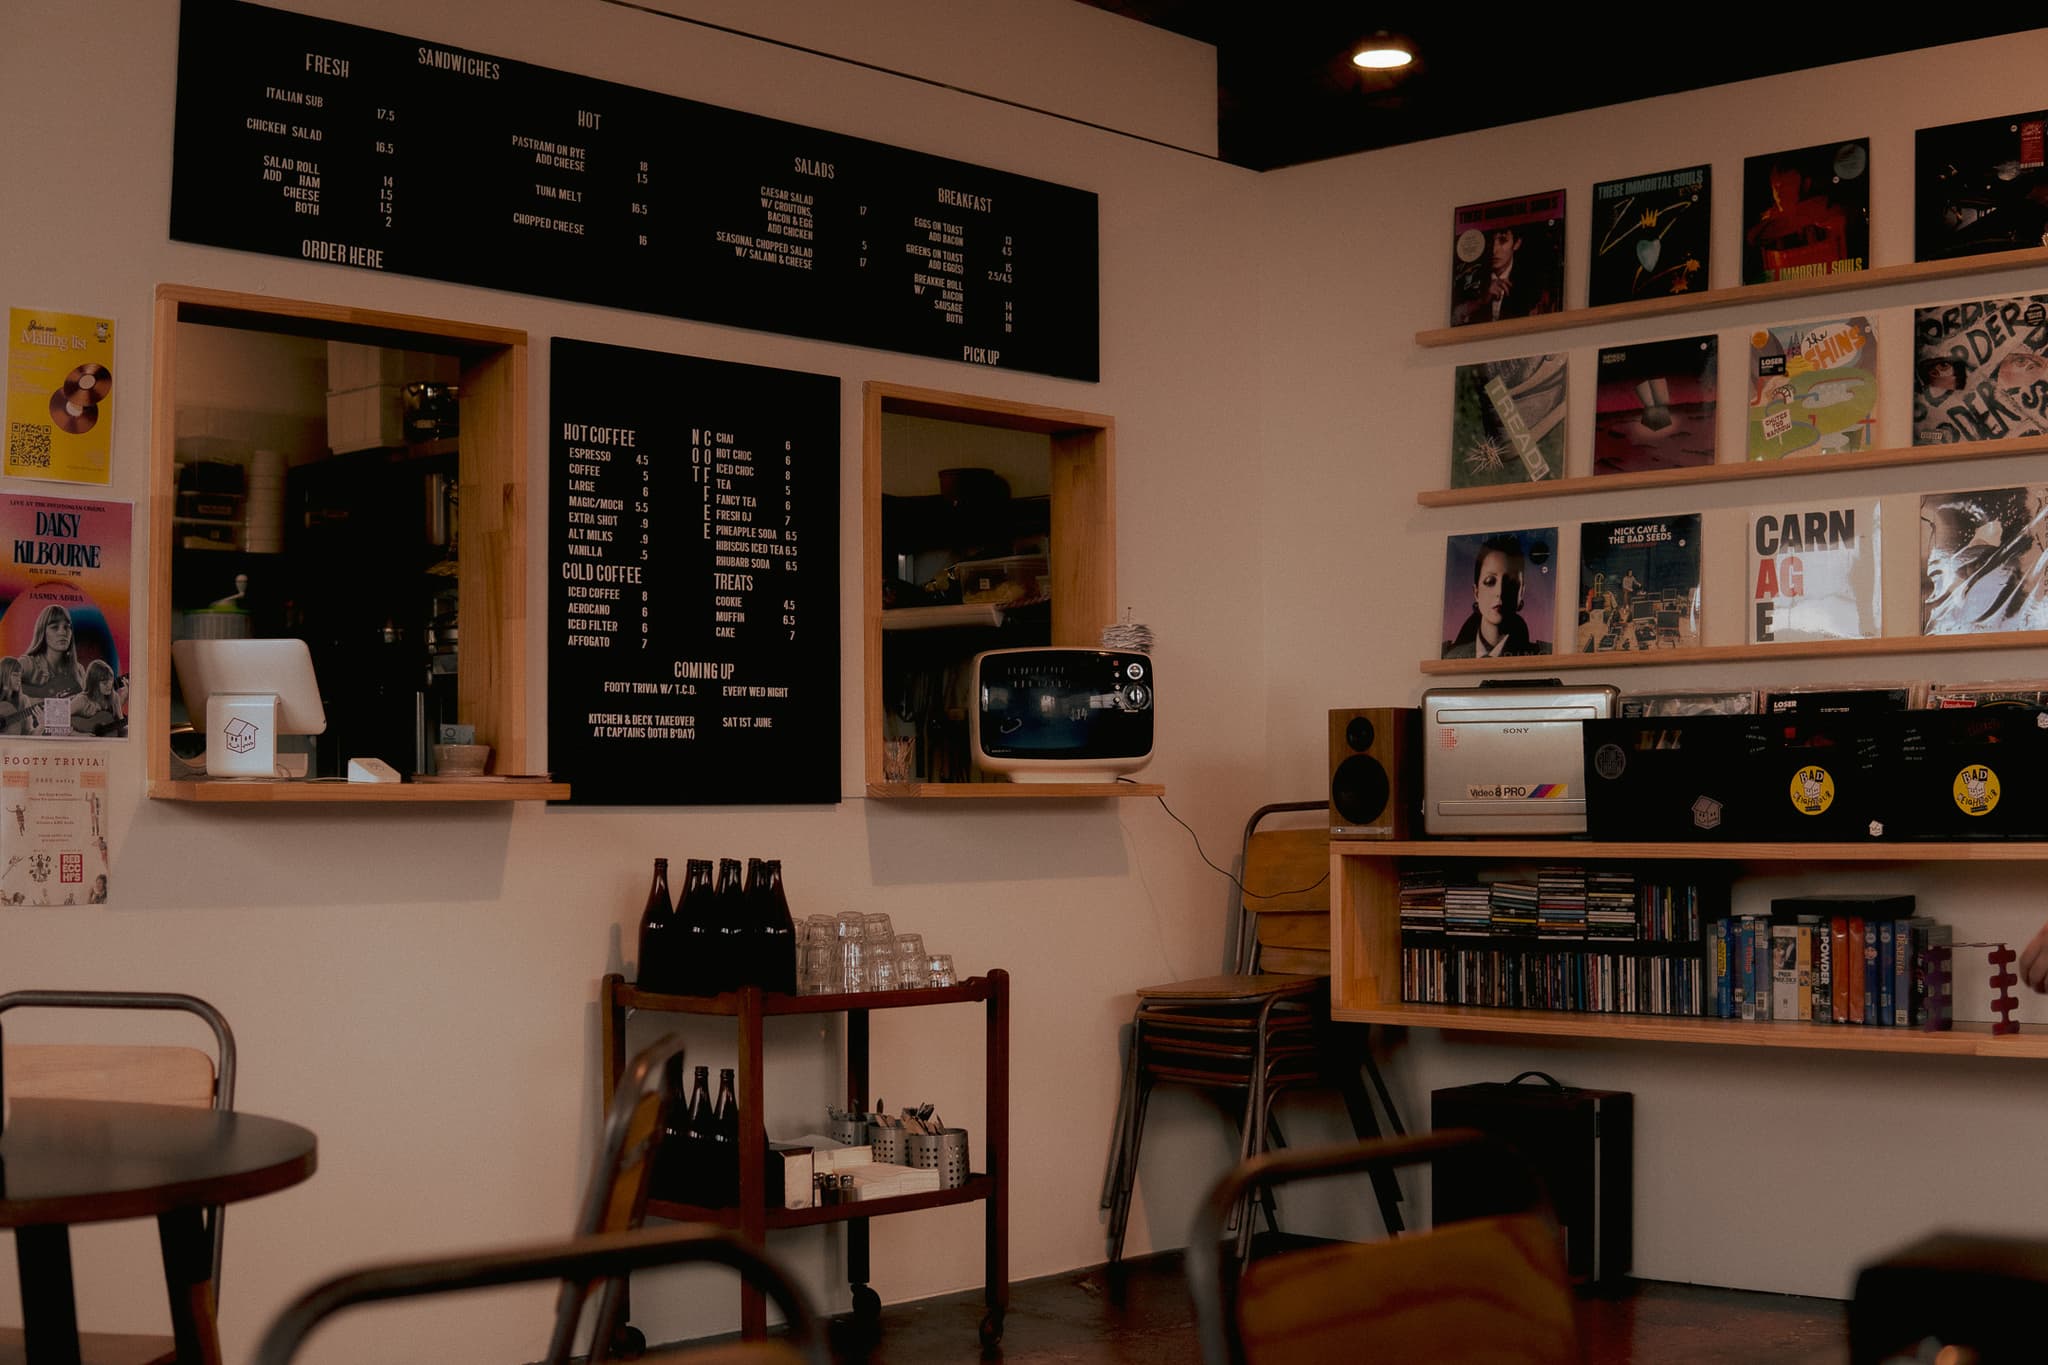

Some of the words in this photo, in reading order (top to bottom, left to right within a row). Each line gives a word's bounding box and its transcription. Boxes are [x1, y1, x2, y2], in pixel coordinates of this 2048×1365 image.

[305, 53, 350, 78] FRESH
[418, 48, 500, 80] SANDWICHES
[266, 86, 303, 104] ITALIAN
[305, 95, 324, 108] SUB
[377, 108, 395, 121] 17.5
[578, 110, 601, 131] HOT
[247, 118, 286, 135] CHICKEN
[292, 125, 322, 141] SALAD
[376, 142, 394, 154] 16.5
[512, 135, 555, 154] PASTRAMI
[557, 143, 568, 157] ON
[570, 147, 586, 160] RYE
[263, 155, 294, 171] SALAD
[296, 160, 321, 175] ROLL
[536, 153, 551, 166] ADD
[554, 156, 585, 172] CHEESE
[794, 157, 835, 180] SALADS
[263, 168, 282, 182] ADD
[299, 175, 321, 189] HAM
[383, 176, 393, 188] 14
[1598, 183, 1624, 200] THESE
[1625, 176, 1672, 195] IMMORTAL
[1673, 170, 1703, 187] SOULS
[283, 186, 320, 202] CHEESE
[536, 184, 556, 198] TUNA
[558, 189, 582, 203] MELT
[761, 186, 788, 201] CAESAR
[790, 192, 814, 205] SALAD
[938, 187, 992, 213] BREAKFAST
[295, 202, 320, 216] BOTH
[513, 212, 551, 230] CHOPPED
[553, 219, 585, 235] CHEESE
[768, 211, 790, 224] BACON
[800, 218, 813, 228] EGG
[914, 217, 931, 228] EGGS
[943, 223, 963, 236] TOAST
[768, 223, 782, 234] ADD
[783, 226, 813, 240] CHICKEN
[716, 231, 754, 248] SEASONAL
[756, 238, 788, 254] CHOPPED
[790, 244, 813, 258] SALAD
[929, 232, 941, 242] ADD
[943, 234, 964, 247] BACON
[302, 239, 346, 263] ORDER
[349, 245, 384, 269] HERE
[749, 249, 777, 263] SALAMI
[786, 256, 813, 270] CHEESE
[906, 244, 931, 257] GREENS
[943, 251, 964, 263] TOAST
[1779, 261, 1831, 281] IMMORTAL
[947, 280, 964, 291] ROLL
[943, 290, 964, 302] BACON
[934, 300, 963, 313] SAUSAGE
[946, 313, 963, 324] BOTH
[21, 330, 68, 351] Mailing
[72, 336, 87, 349] list
[1806, 331, 1827, 348] the
[1804, 325, 1866, 370] SHINS
[964, 345, 986, 364] PICK
[987, 350, 1000, 366] UP
[1761, 358, 1784, 366] LOSER
[1765, 412, 1788, 427] CHUTES
[563, 422, 589, 443] HOT
[590, 425, 636, 448] COFFEE
[716, 432, 734, 445] CHAI
[569, 447, 612, 462] ESPRESSO
[635, 453, 649, 465] 4.5
[716, 448, 731, 460] HOT
[732, 450, 752, 462] CHOC
[569, 463, 601, 477] COFFEE
[716, 463, 733, 475] ICED
[734, 465, 755, 477] CHOC
[569, 480, 596, 492] LARGE
[716, 479, 732, 490] TEA
[569, 496, 623, 511] MAGIC/MOCH
[635, 501, 648, 512] 5.5
[716, 494, 740, 507] FANCY
[742, 496, 756, 508] TEA
[568, 512, 596, 525] EXTRA
[597, 514, 619, 527] SHOT
[716, 509, 740, 521] FRESH
[36, 511, 81, 538] DAISY
[1614, 526, 1635, 536] NICK
[1637, 525, 1658, 534] CAVE
[1661, 524, 1666, 532] &
[568, 528, 584, 540] ALT
[586, 529, 613, 542] MILKS
[716, 525, 756, 538] PINEAPPLE
[758, 528, 777, 541] SODA
[1608, 536, 1625, 544] THE
[1627, 534, 1644, 543] BAD
[1646, 532, 1672, 542] SEEDS
[1755, 509, 1855, 556] CARN
[14, 539, 101, 569] KILBOURNE
[568, 544, 603, 558] VANILLA
[716, 540, 750, 552] HIBISCUS
[751, 542, 769, 555] ICED
[770, 544, 784, 556] TEA
[716, 556, 750, 568] RHUBARB
[751, 558, 770, 570] SODA
[562, 562, 594, 580] COLD
[596, 565, 642, 584] COFFEE
[1755, 556, 1805, 600] AG
[714, 572, 754, 591] TREATS
[568, 586, 588, 598] ICED
[589, 587, 620, 600] COFFEE
[568, 602, 610, 616] AEROCANO
[716, 595, 743, 608] COOKIE
[716, 611, 745, 623] MUFFIN
[1756, 601, 1775, 642] E
[568, 619, 588, 631] ICED
[589, 620, 619, 632] FILTER
[716, 627, 735, 639] CAKE
[568, 635, 610, 648] AFFOGATO
[674, 661, 718, 679] COMING
[720, 663, 734, 680] UP
[604, 681, 631, 693] FOOTY
[632, 683, 658, 694] TRIVIA
[723, 685, 747, 697] EVERY
[749, 686, 766, 698] WED
[768, 687, 789, 699] NIGHT
[1774, 700, 1797, 708] LOSER
[589, 713, 623, 725] KITCHEN
[633, 714, 653, 726] DECK
[655, 715, 695, 727] TAKEOVER
[723, 716, 737, 728] SAT
[753, 718, 772, 729] JUNE
[593, 726, 605, 737] AT
[607, 726, 645, 739] CAPTAINS
[4, 757, 48, 765] FOOTY
[55, 758, 105, 767] TRIVIA!
[1799, 769, 1824, 784] BAD
[1961, 769, 1988, 784] BAD
[1470, 788, 1494, 798] Video
[1495, 787, 1502, 797] 8
[1503, 786, 1526, 797] PRO
[1820, 936, 1830, 984] POWDER
